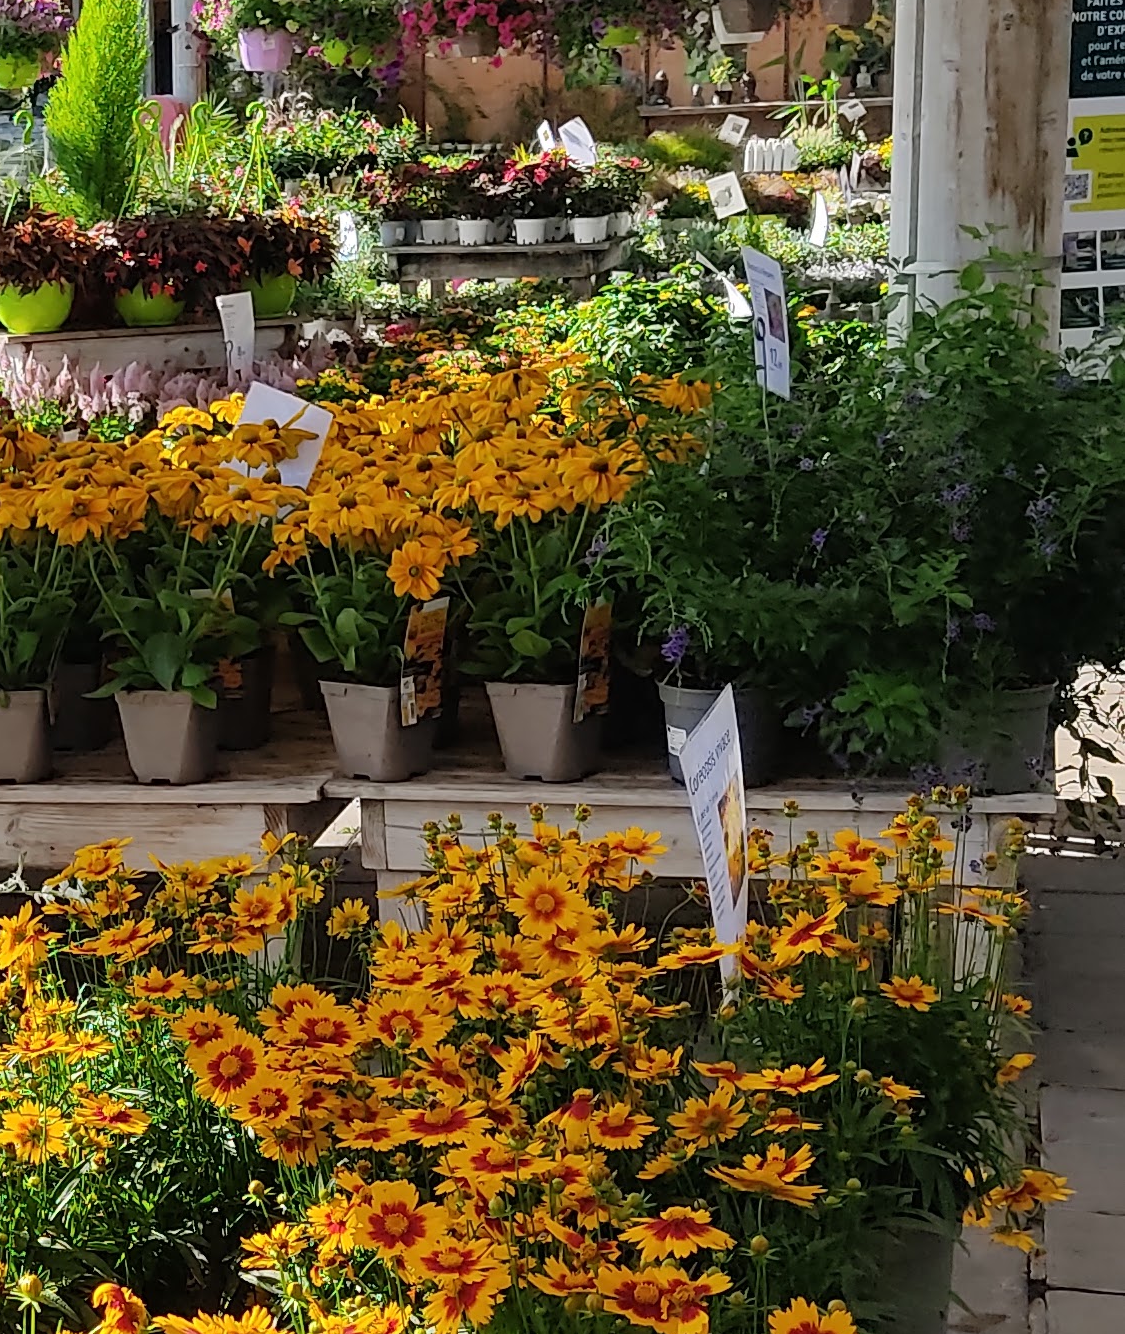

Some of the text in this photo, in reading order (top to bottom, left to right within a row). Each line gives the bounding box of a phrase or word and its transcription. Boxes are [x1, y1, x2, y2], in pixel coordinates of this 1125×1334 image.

[1072, 9, 1125, 22] NOTRE CO
[1088, 42, 1112, 54] pour
[1081, 56, 1092, 66] et
[1081, 69, 1094, 81] de
[1096, 70, 1121, 80] votre
